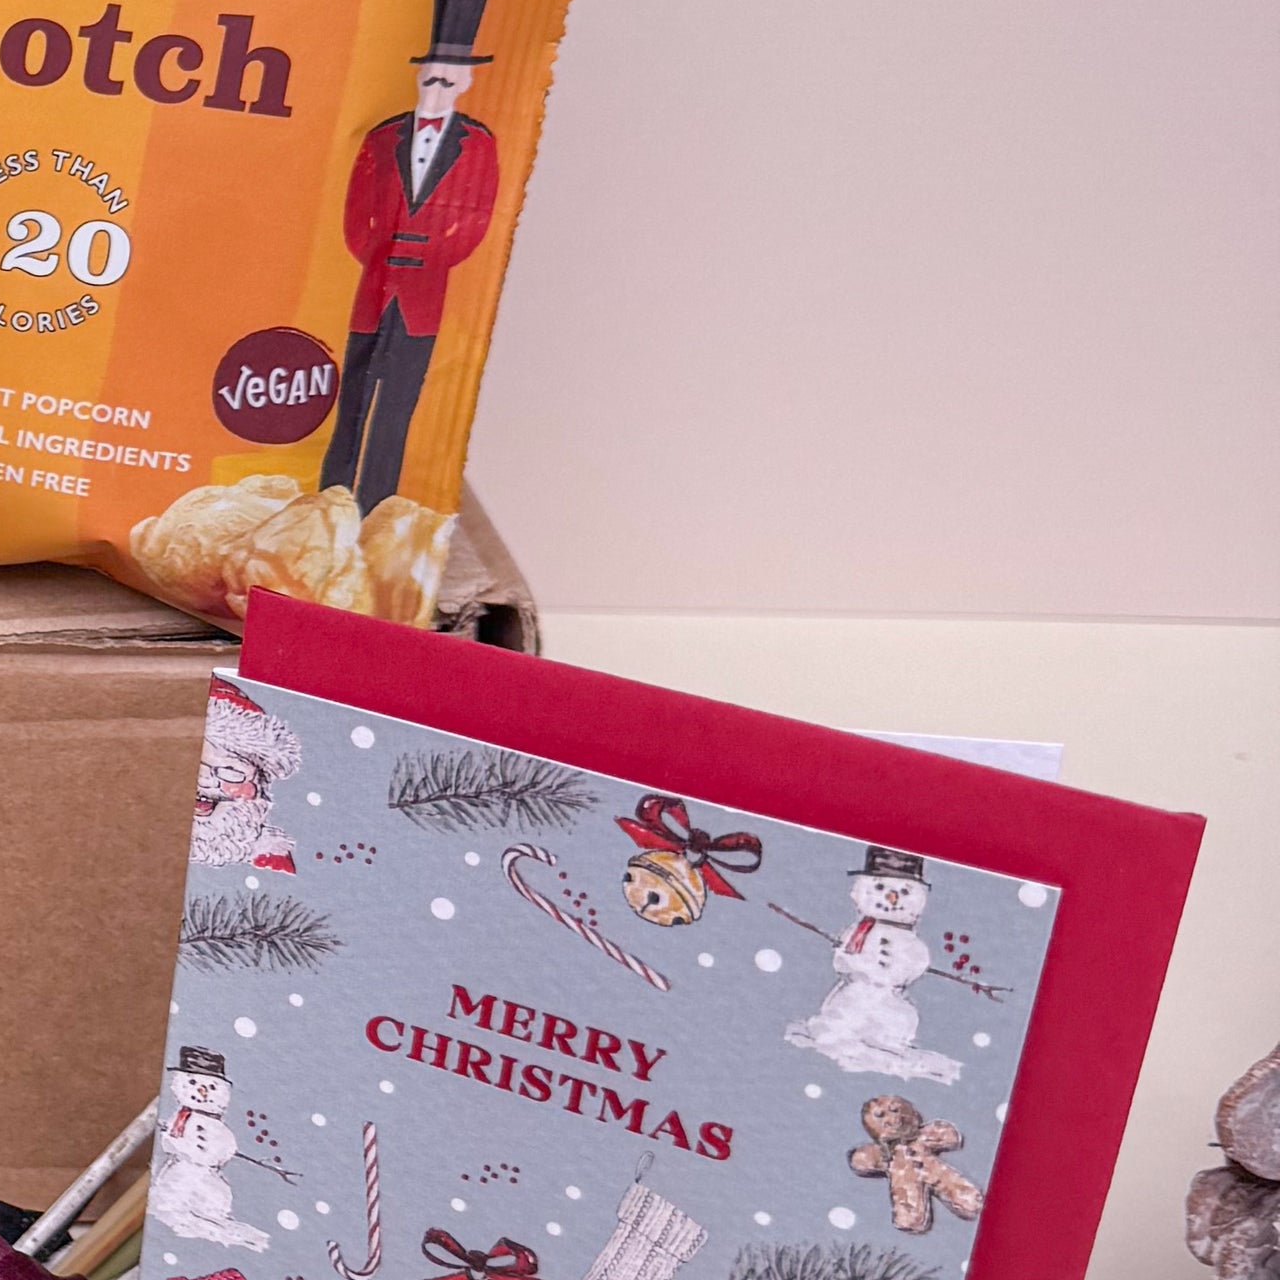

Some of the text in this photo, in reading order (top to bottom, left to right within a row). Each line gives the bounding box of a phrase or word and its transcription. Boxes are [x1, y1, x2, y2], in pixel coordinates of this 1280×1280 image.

[52, 149, 129, 214] THAN
[21, 391, 152, 429] POPCORN
[16, 429, 192, 472] INGREDIENTS
[30, 470, 91, 497] FREE
[447, 984, 667, 1081] MERRY
[365, 1016, 733, 1161] CHRISTMAS
